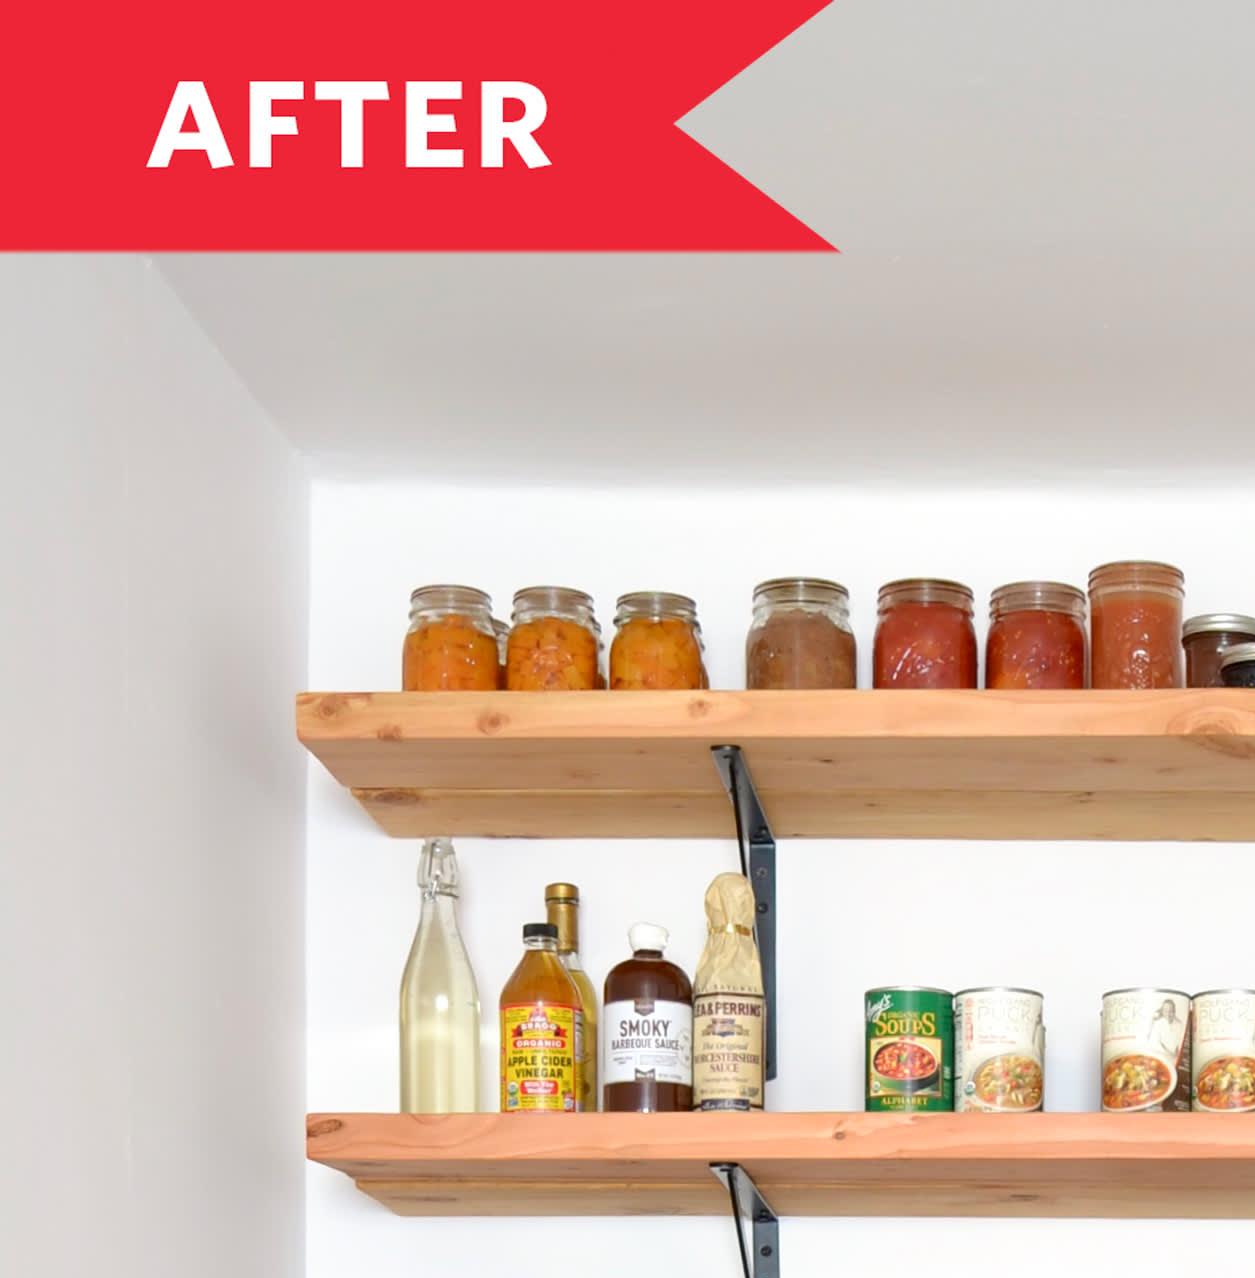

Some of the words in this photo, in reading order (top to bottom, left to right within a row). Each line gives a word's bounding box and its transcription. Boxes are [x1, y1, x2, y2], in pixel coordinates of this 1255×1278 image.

[619, 1019, 671, 1037] SMOKY
[874, 1012, 937, 1037] SOUPS
[516, 1039, 563, 1048] ORGANIC
[611, 1037, 651, 1050] BARBEQUE
[654, 1038, 680, 1050] SAUCE
[508, 1055, 537, 1067] APPLE
[541, 1055, 573, 1067] CIDER
[515, 1067, 564, 1079] VINEGAR
[709, 1063, 740, 1073] SAUCE
